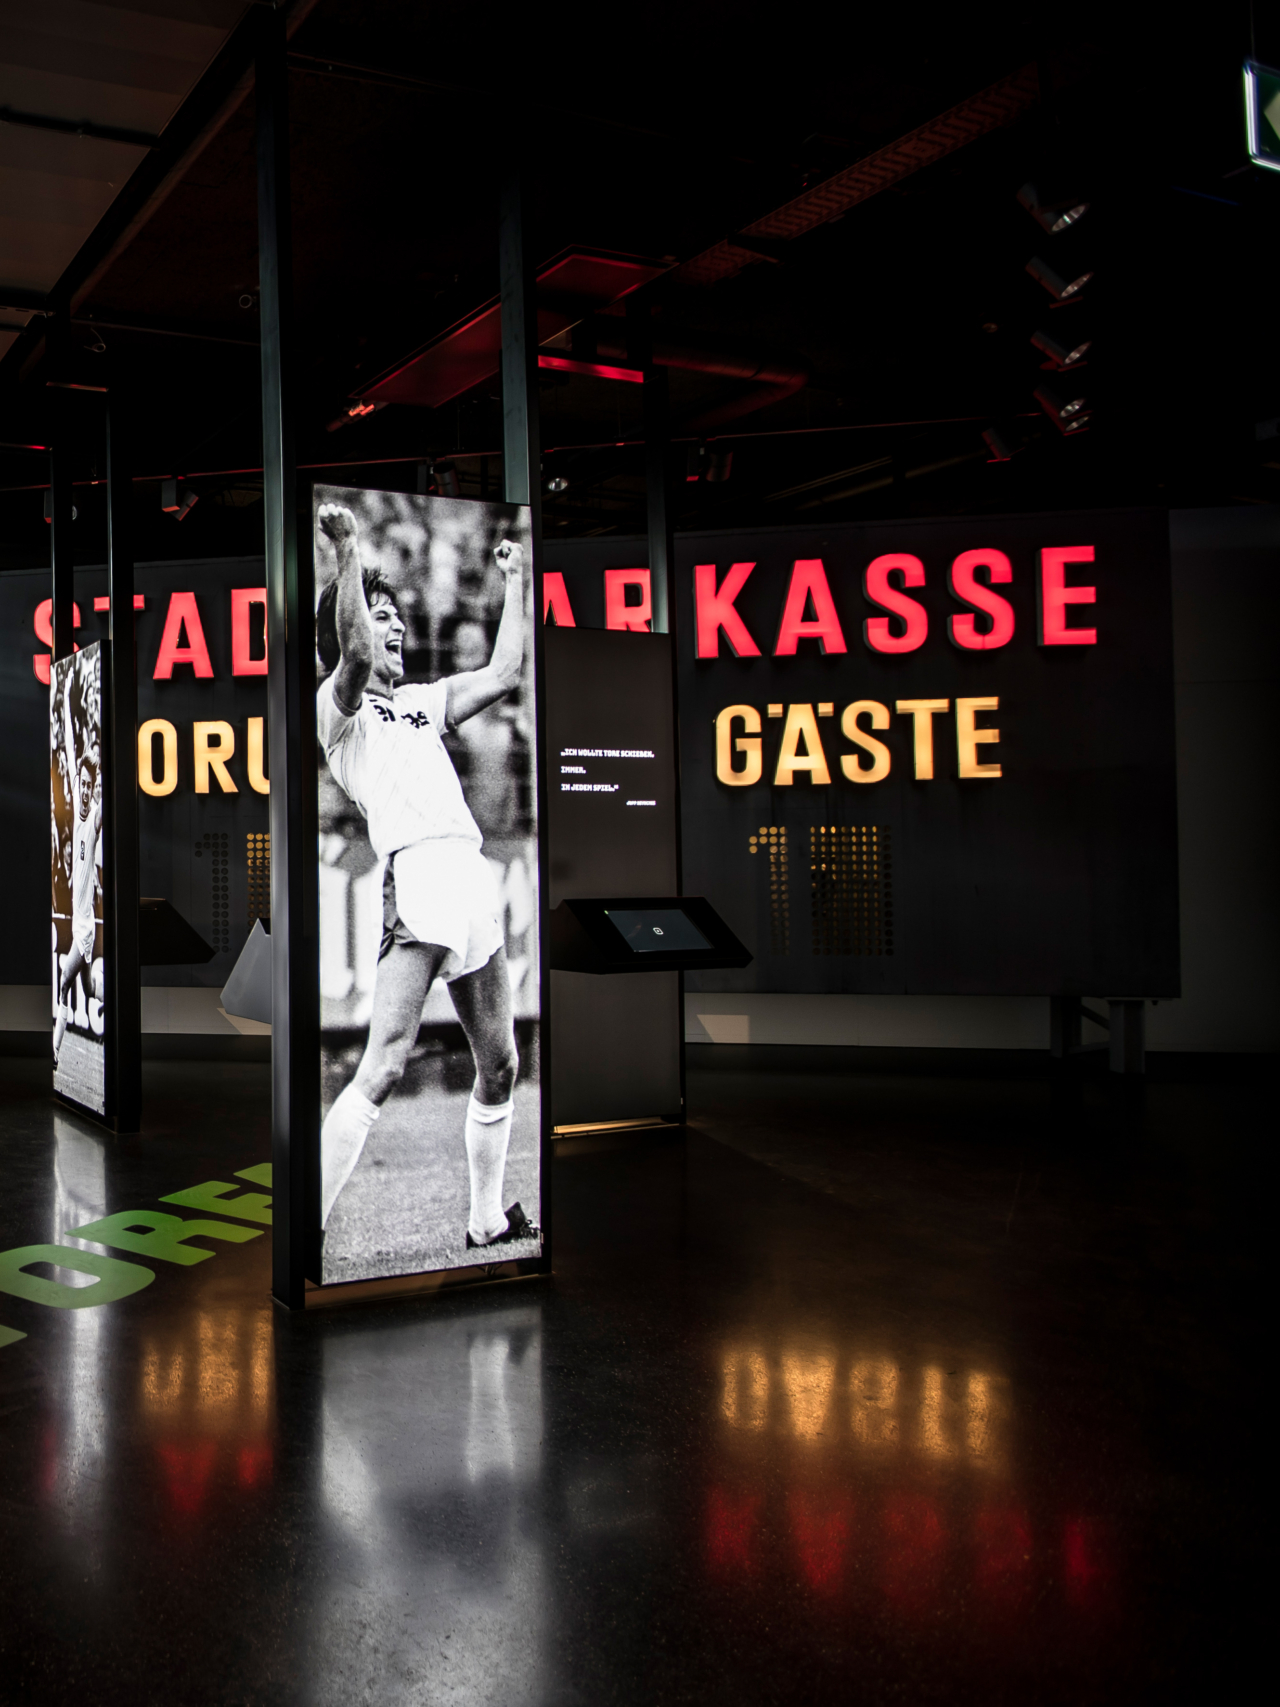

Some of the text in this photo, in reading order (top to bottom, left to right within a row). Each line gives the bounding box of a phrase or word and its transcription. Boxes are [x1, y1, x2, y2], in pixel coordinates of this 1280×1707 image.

[715, 696, 1002, 787] GÄSTE
[578, 748, 603, 756] WOLLTE
[604, 749, 620, 757] TORE
[561, 766, 586, 774] IMMER.
[561, 783, 570, 791] IN
